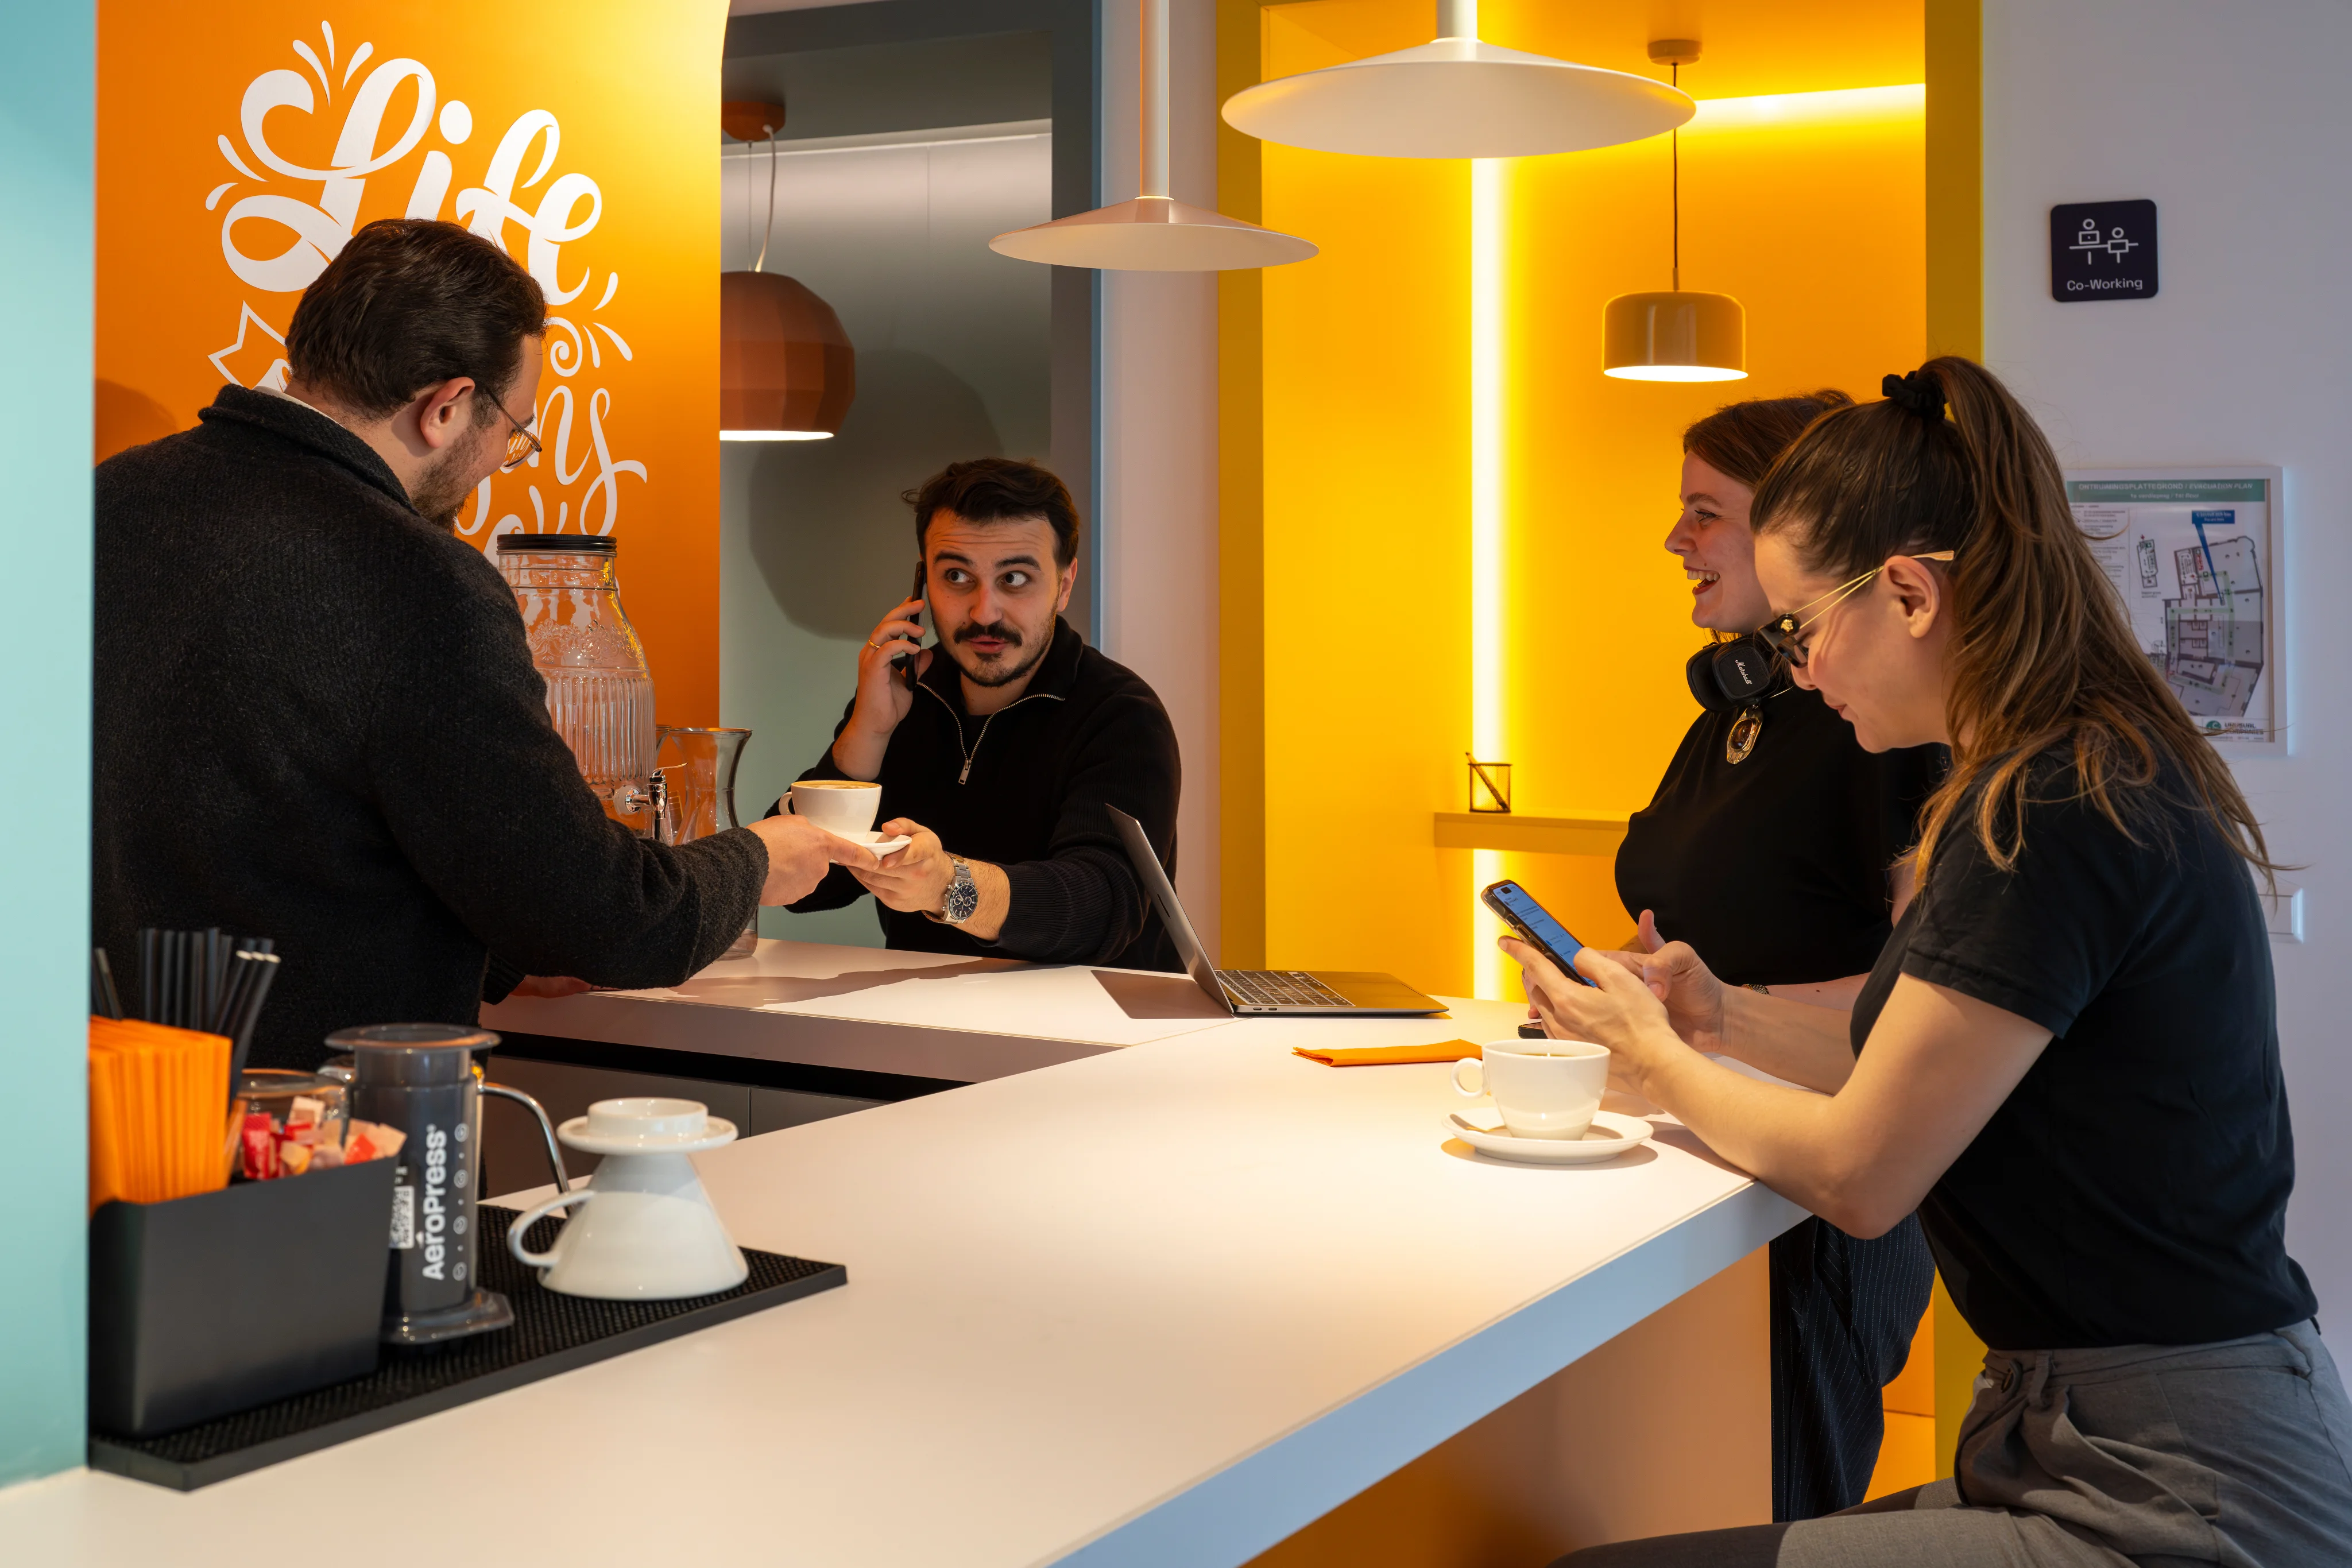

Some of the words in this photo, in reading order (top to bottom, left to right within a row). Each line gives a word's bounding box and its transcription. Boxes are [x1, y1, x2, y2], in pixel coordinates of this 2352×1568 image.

[221, 57, 602, 306] Life
[2067, 278, 2142, 291] Co-Working
[1735, 660, 1753, 685] Marshall
[422, 1129, 447, 1280] AeroPress
